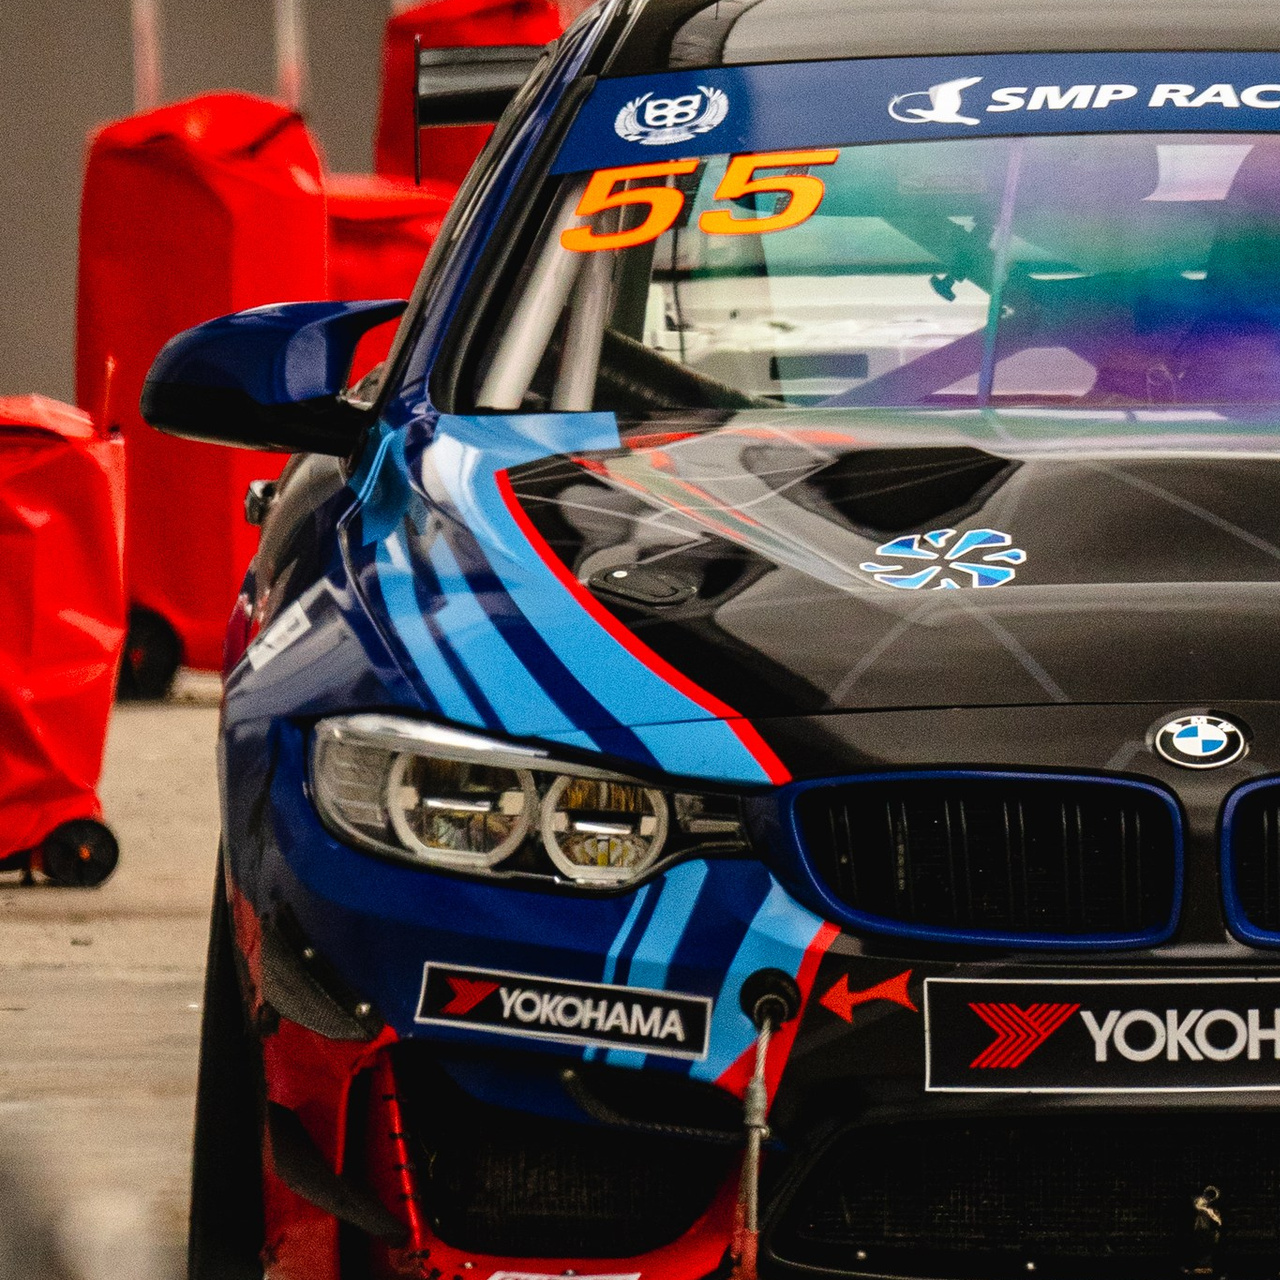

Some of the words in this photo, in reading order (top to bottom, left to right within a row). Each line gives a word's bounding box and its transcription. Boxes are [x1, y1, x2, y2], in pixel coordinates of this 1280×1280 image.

[986, 84, 1138, 112] SMP
[560, 150, 840, 252] 55
[499, 987, 685, 1042] YOKOHAMA
